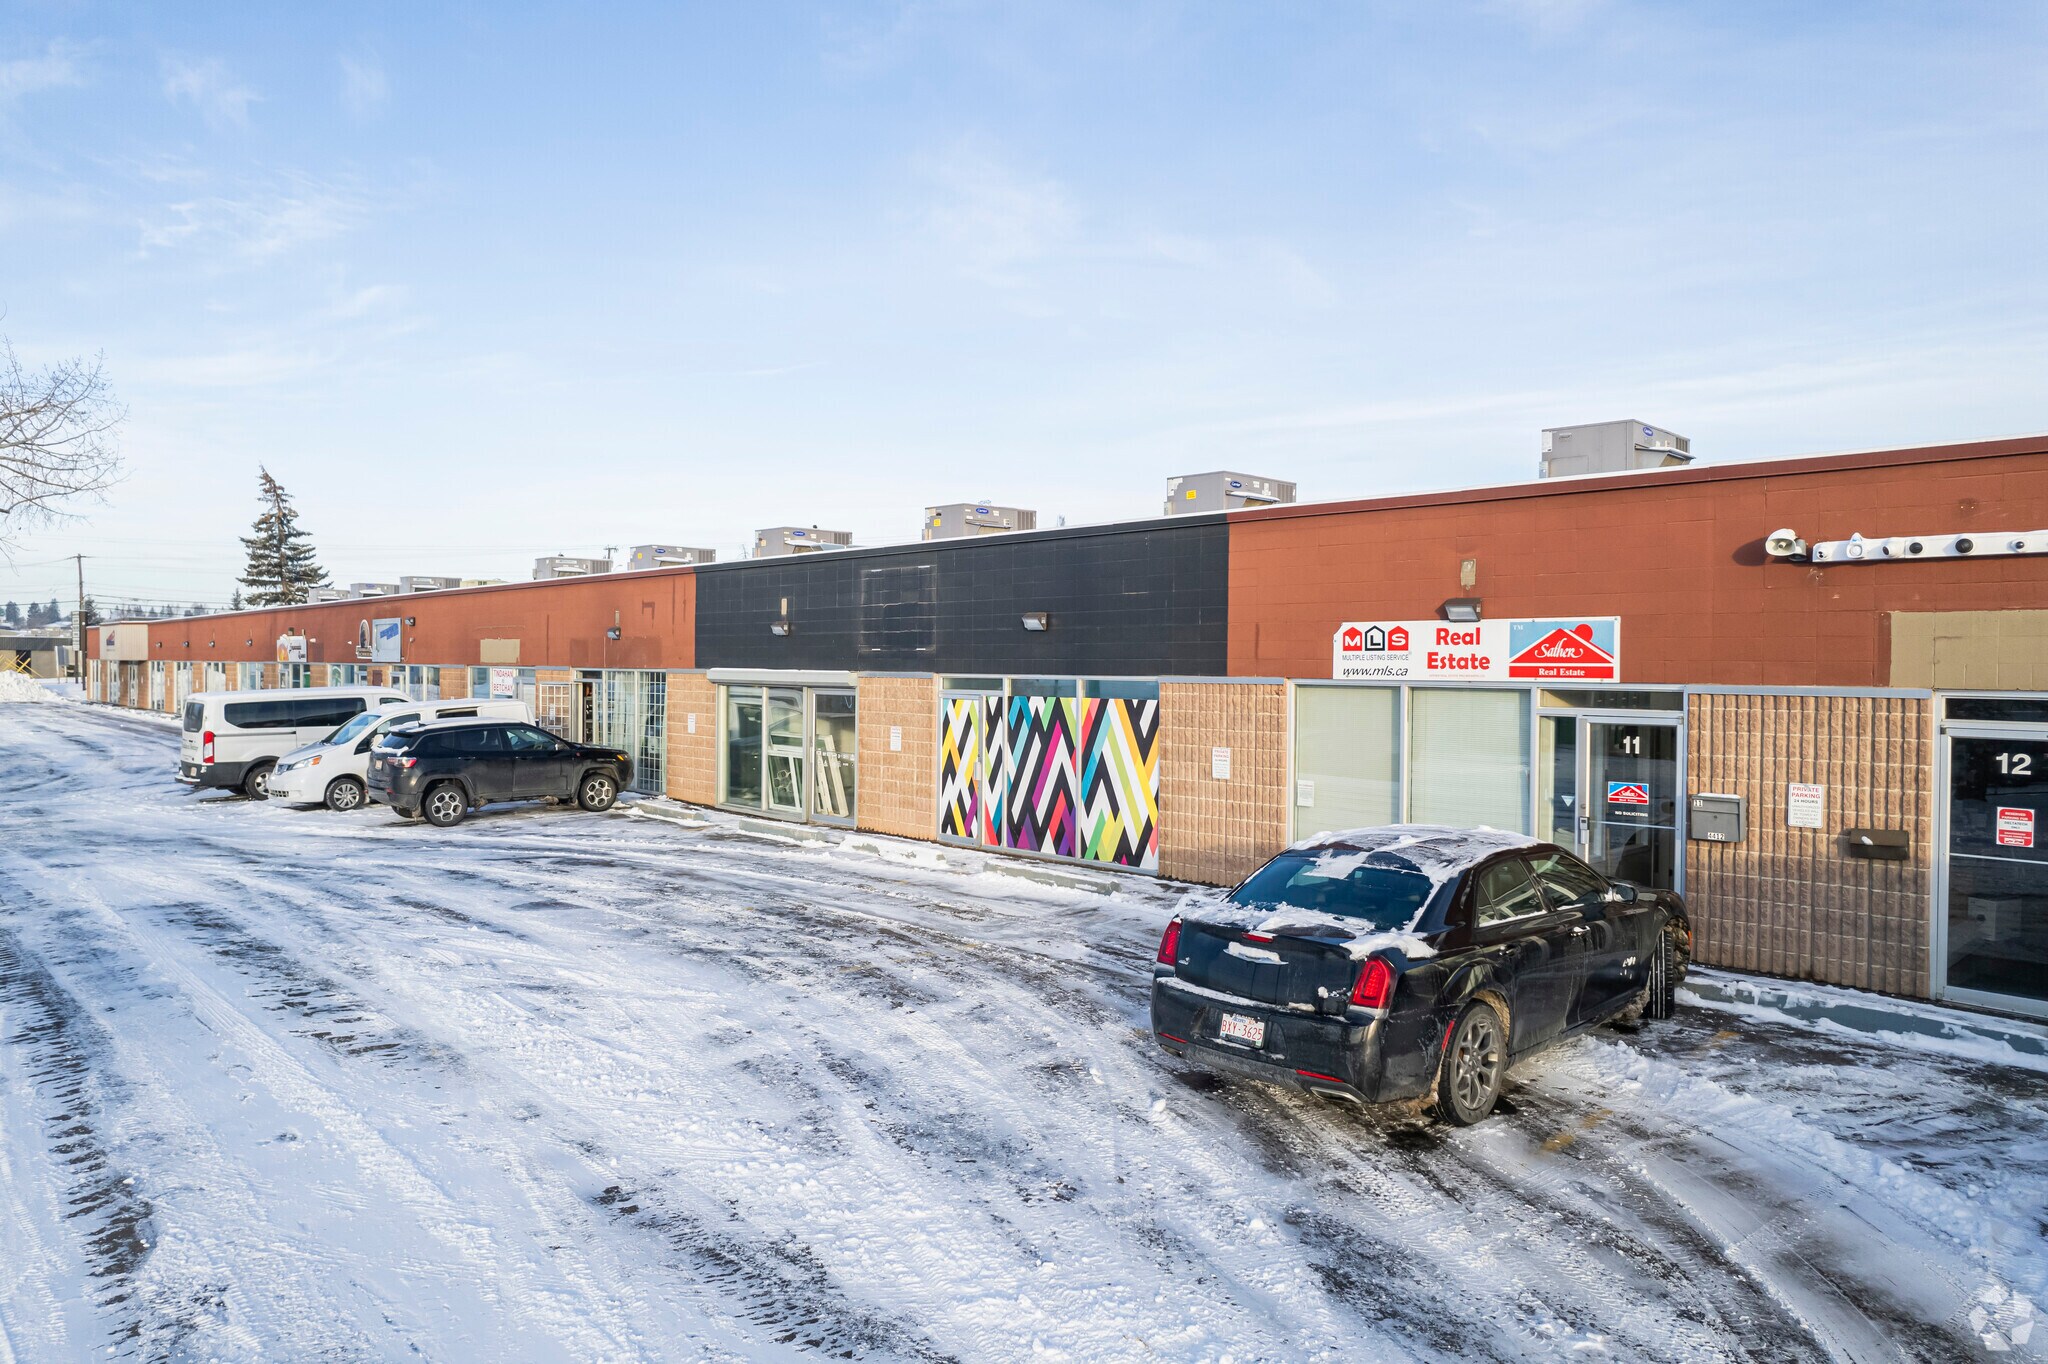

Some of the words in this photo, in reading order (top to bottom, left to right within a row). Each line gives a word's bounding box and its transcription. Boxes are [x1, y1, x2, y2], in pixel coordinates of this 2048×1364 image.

[1344, 632, 1407, 648] MLS
[1436, 627, 1481, 646] Real
[1534, 637, 1584, 658] Sather
[1427, 651, 1491, 670] Estate
[1342, 665, 1409, 677] www.mls.ca
[1539, 668, 1557, 676] Real
[1560, 668, 1586, 676] Estate
[1623, 735, 1641, 754] 11
[1996, 753, 2031, 775] 12
[1222, 1020, 1262, 1040] BXY-3625
